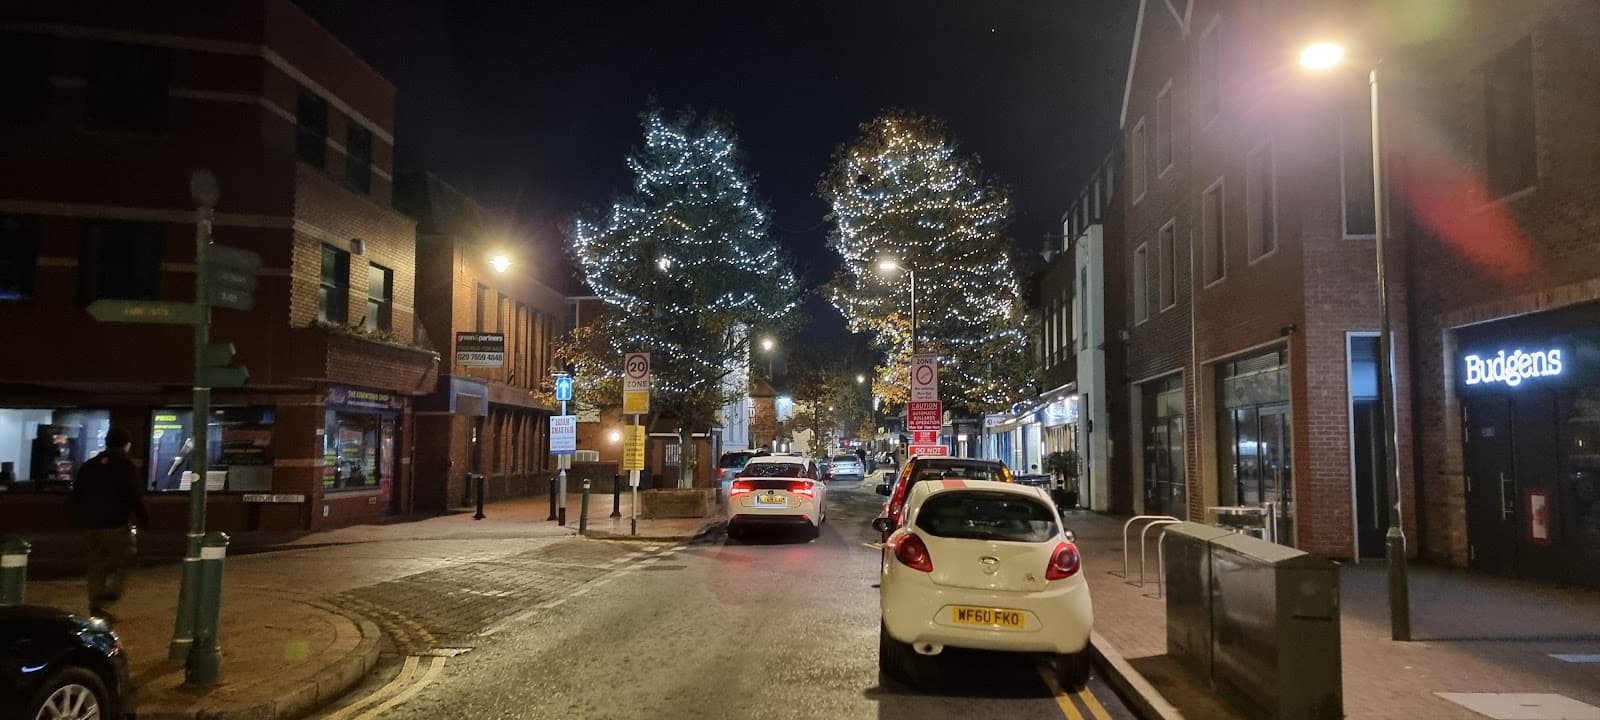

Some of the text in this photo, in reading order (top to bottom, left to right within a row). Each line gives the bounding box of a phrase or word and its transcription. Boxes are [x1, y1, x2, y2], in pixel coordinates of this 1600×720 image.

[630, 362, 645, 372] 20
[1465, 349, 1562, 386] Budgens
[627, 380, 648, 388] ZONE
[957, 608, 991, 623] WF60
